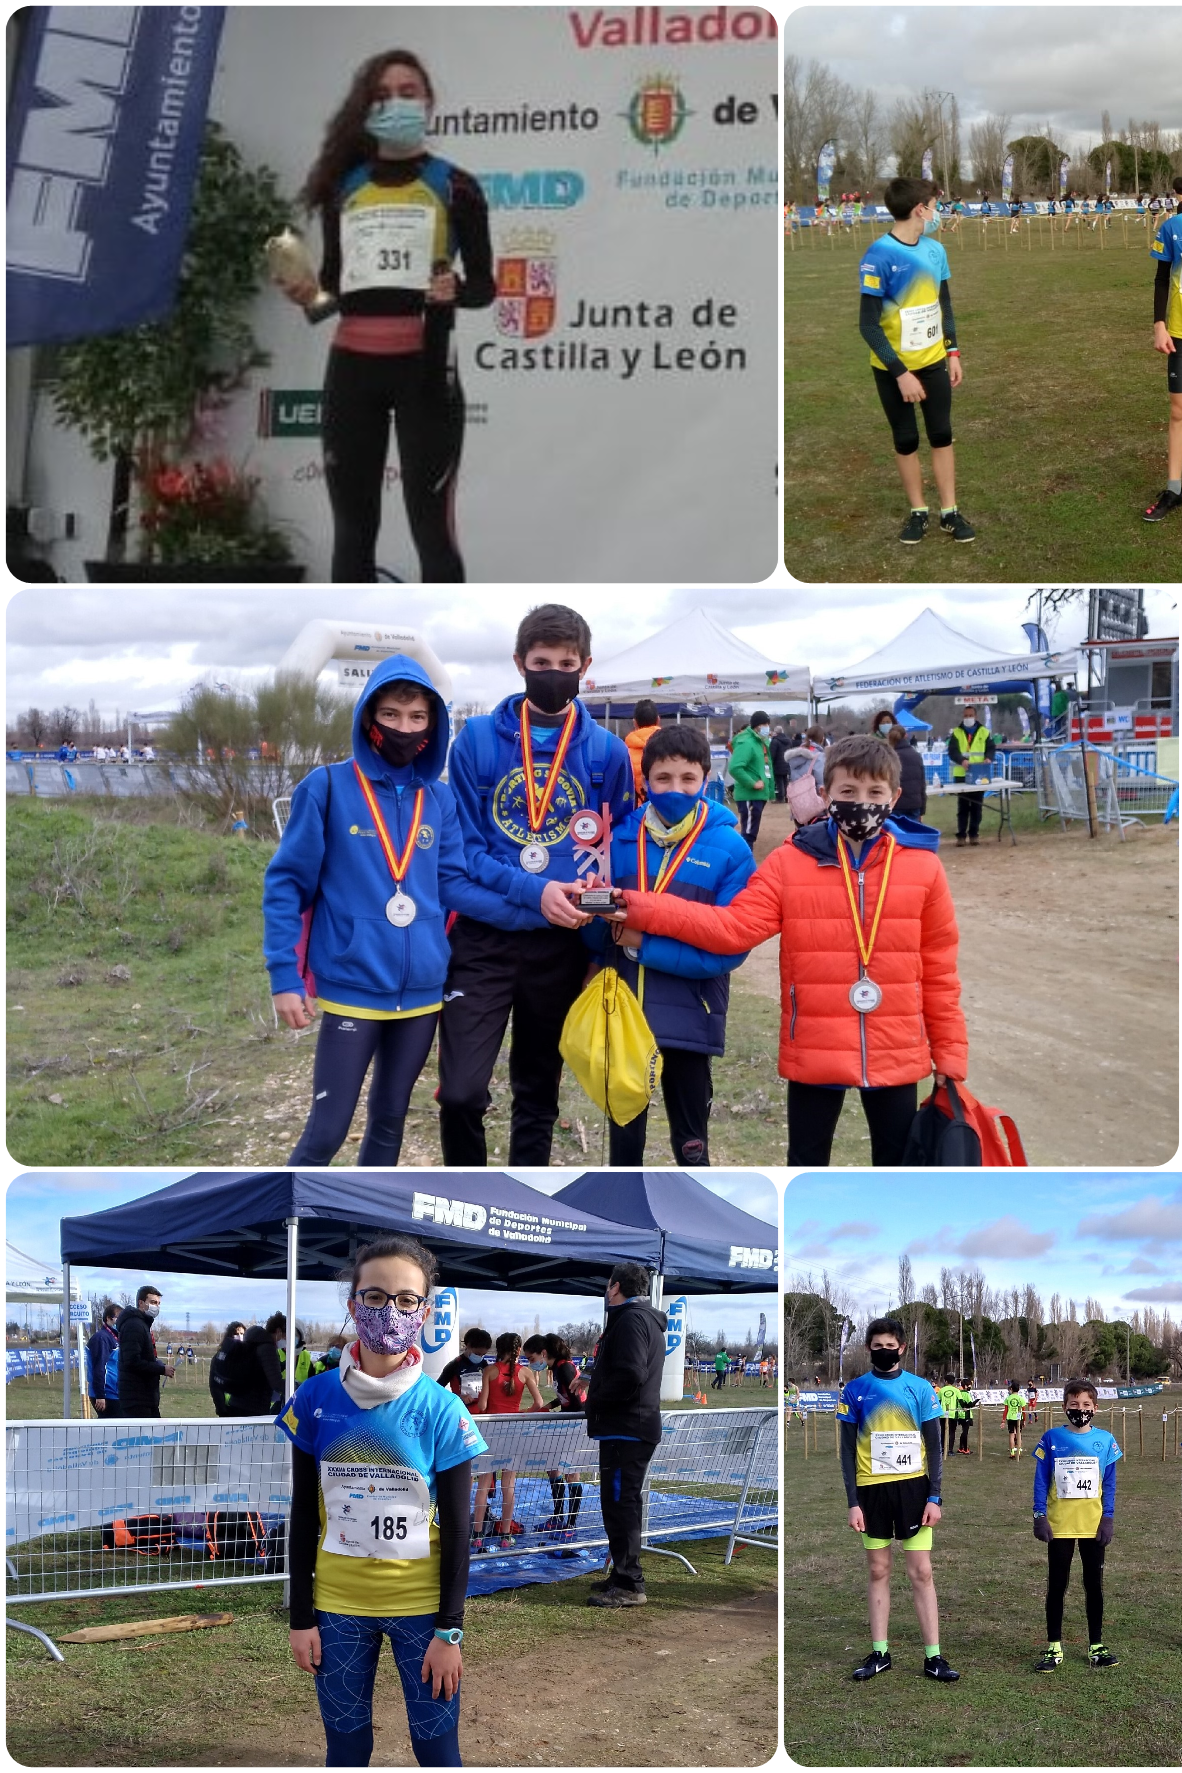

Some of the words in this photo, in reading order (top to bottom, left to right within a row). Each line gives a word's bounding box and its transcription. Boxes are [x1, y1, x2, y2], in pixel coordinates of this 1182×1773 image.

[130, 6, 202, 235] Ayuntamiento
[713, 95, 758, 125] de
[378, 249, 411, 271] 331
[569, 299, 674, 329] Junta
[691, 298, 738, 328] de
[474, 341, 610, 371] Castilla
[619, 348, 642, 380] y
[652, 340, 748, 371] León
[855, 676, 901, 690] FEDERACIÓN
[903, 675, 914, 684] DE
[914, 671, 954, 683] ATLETISMO
[955, 669, 965, 679] DE
[966, 666, 1001, 679] CASTILLA
[1001, 665, 1008, 674] Y
[1008, 662, 1029, 674] LEÓN
[411, 1191, 488, 1231] FMD
[489, 1206, 539, 1223] Fundación
[541, 1216, 587, 1232] Municipal
[487, 1226, 501, 1238] de
[503, 1230, 552, 1245] Valladolid
[488, 1217, 501, 1227] de
[503, 1219, 553, 1236] Deportes
[728, 1245, 774, 1271] FMD
[434, 1294, 452, 1343] FMD
[667, 1303, 683, 1347] FMD
[369, 1467, 419, 1478] INTERNACIONAL
[896, 1454, 912, 1466] 441
[369, 1473, 419, 1482] VALLADOLID
[1076, 1480, 1092, 1491] 442
[370, 1515, 408, 1541] 185
